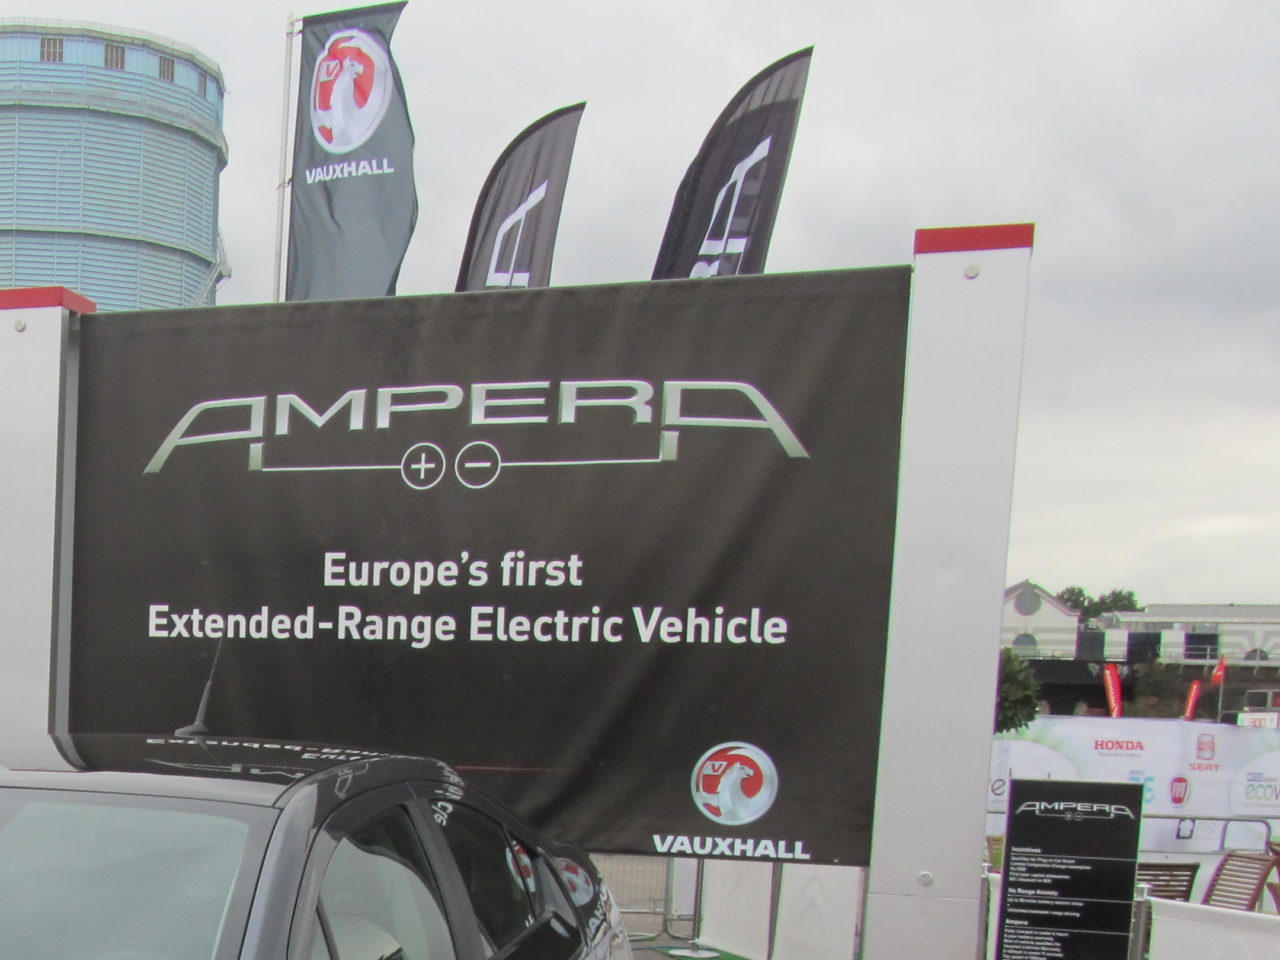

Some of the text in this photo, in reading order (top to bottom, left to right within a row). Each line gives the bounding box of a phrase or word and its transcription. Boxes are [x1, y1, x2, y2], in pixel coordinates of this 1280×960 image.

[305, 157, 395, 184] VAUXHALL
[142, 379, 811, 475] AMPERA
[323, 551, 583, 596] Europe's first
[147, 605, 790, 648] Extended-Range Electric Vehicle
[1094, 740, 1144, 750] HONDA
[1189, 763, 1220, 771] SEAT
[1015, 801, 1135, 819] AMPERA
[652, 834, 810, 860] VAUXHALL
